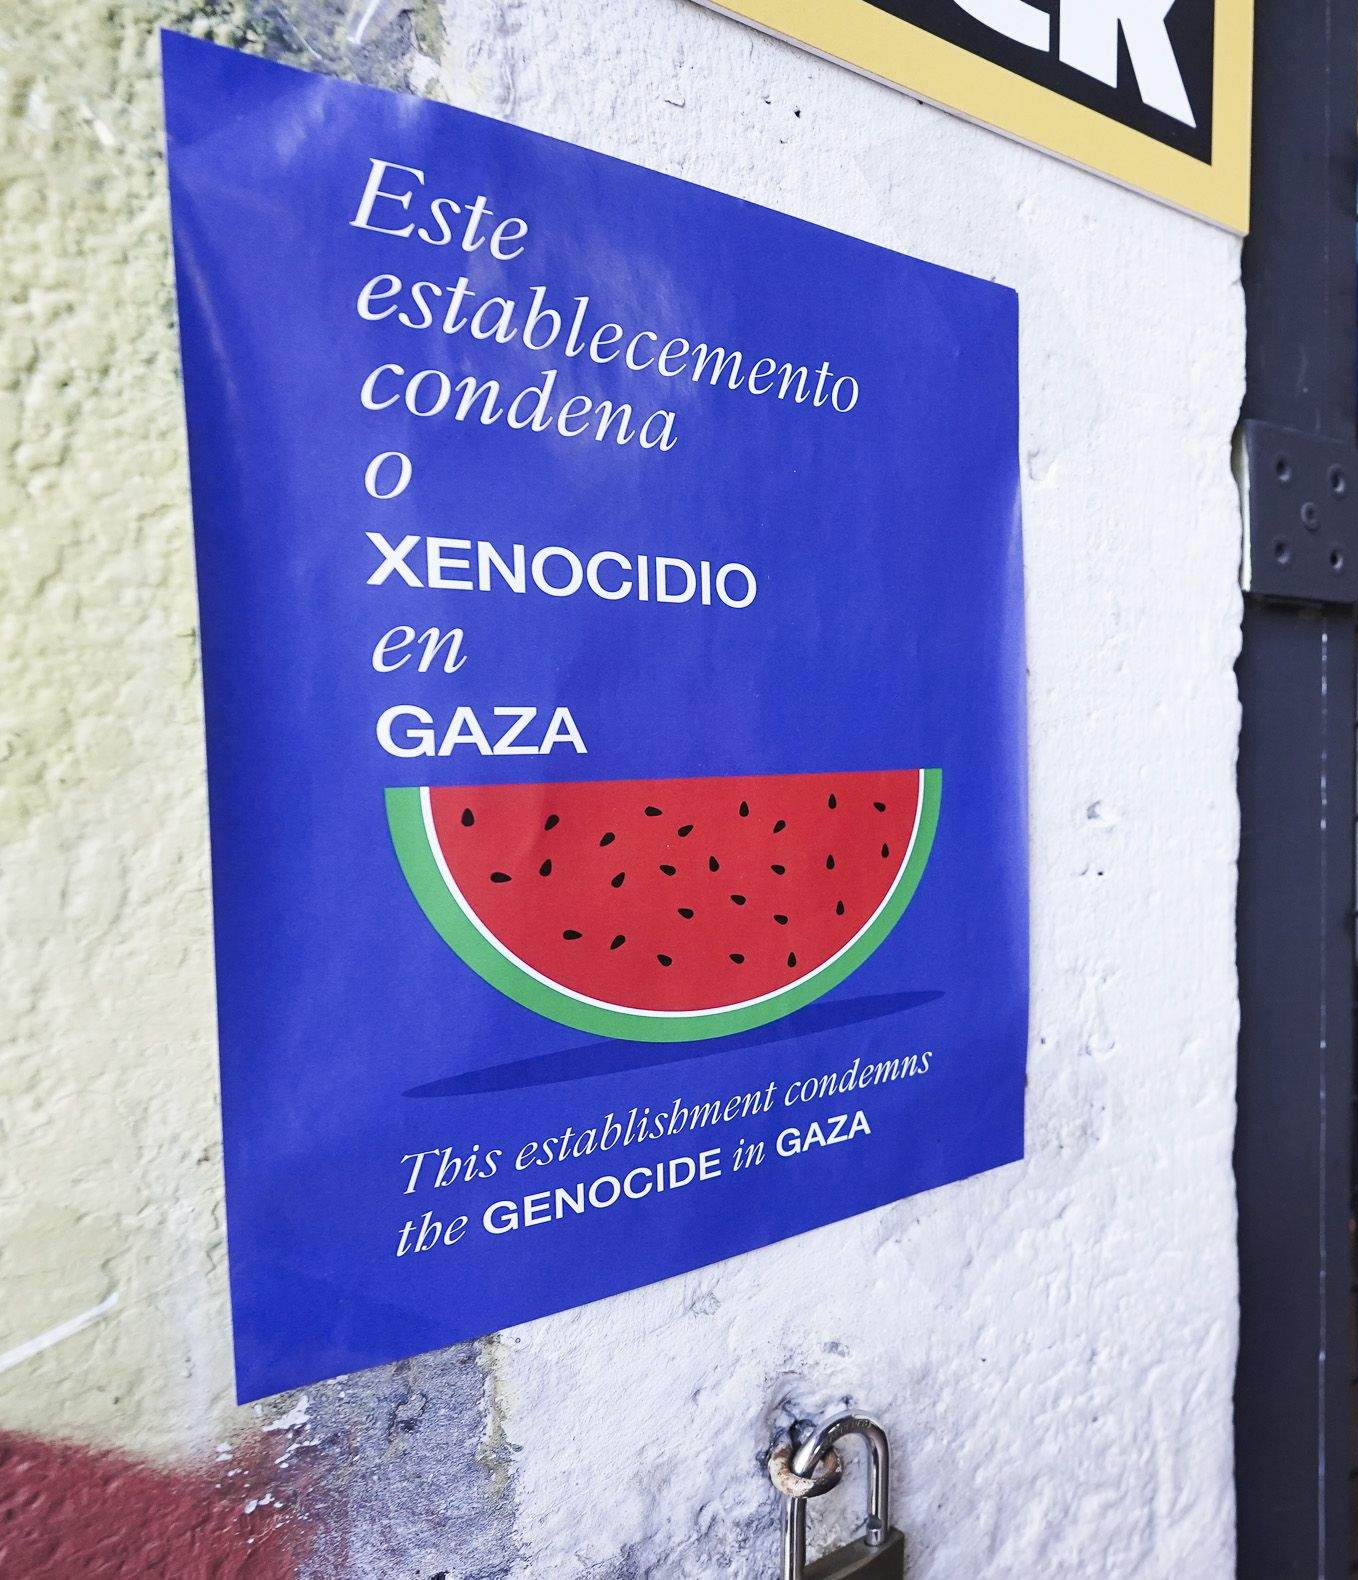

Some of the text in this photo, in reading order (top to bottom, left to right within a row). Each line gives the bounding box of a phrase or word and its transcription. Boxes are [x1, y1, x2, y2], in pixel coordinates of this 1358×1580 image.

[349, 157, 528, 260] Este
[356, 274, 859, 413] establecemento
[360, 361, 678, 451] condena
[364, 451, 413, 500] o
[364, 531, 757, 608] XENOCIDIO
[371, 625, 468, 673] en
[376, 705, 588, 758] GAZA
[401, 1050, 933, 1195] This establishment condemns
[396, 1110, 872, 1257] the GENOCIDE in GAZA
